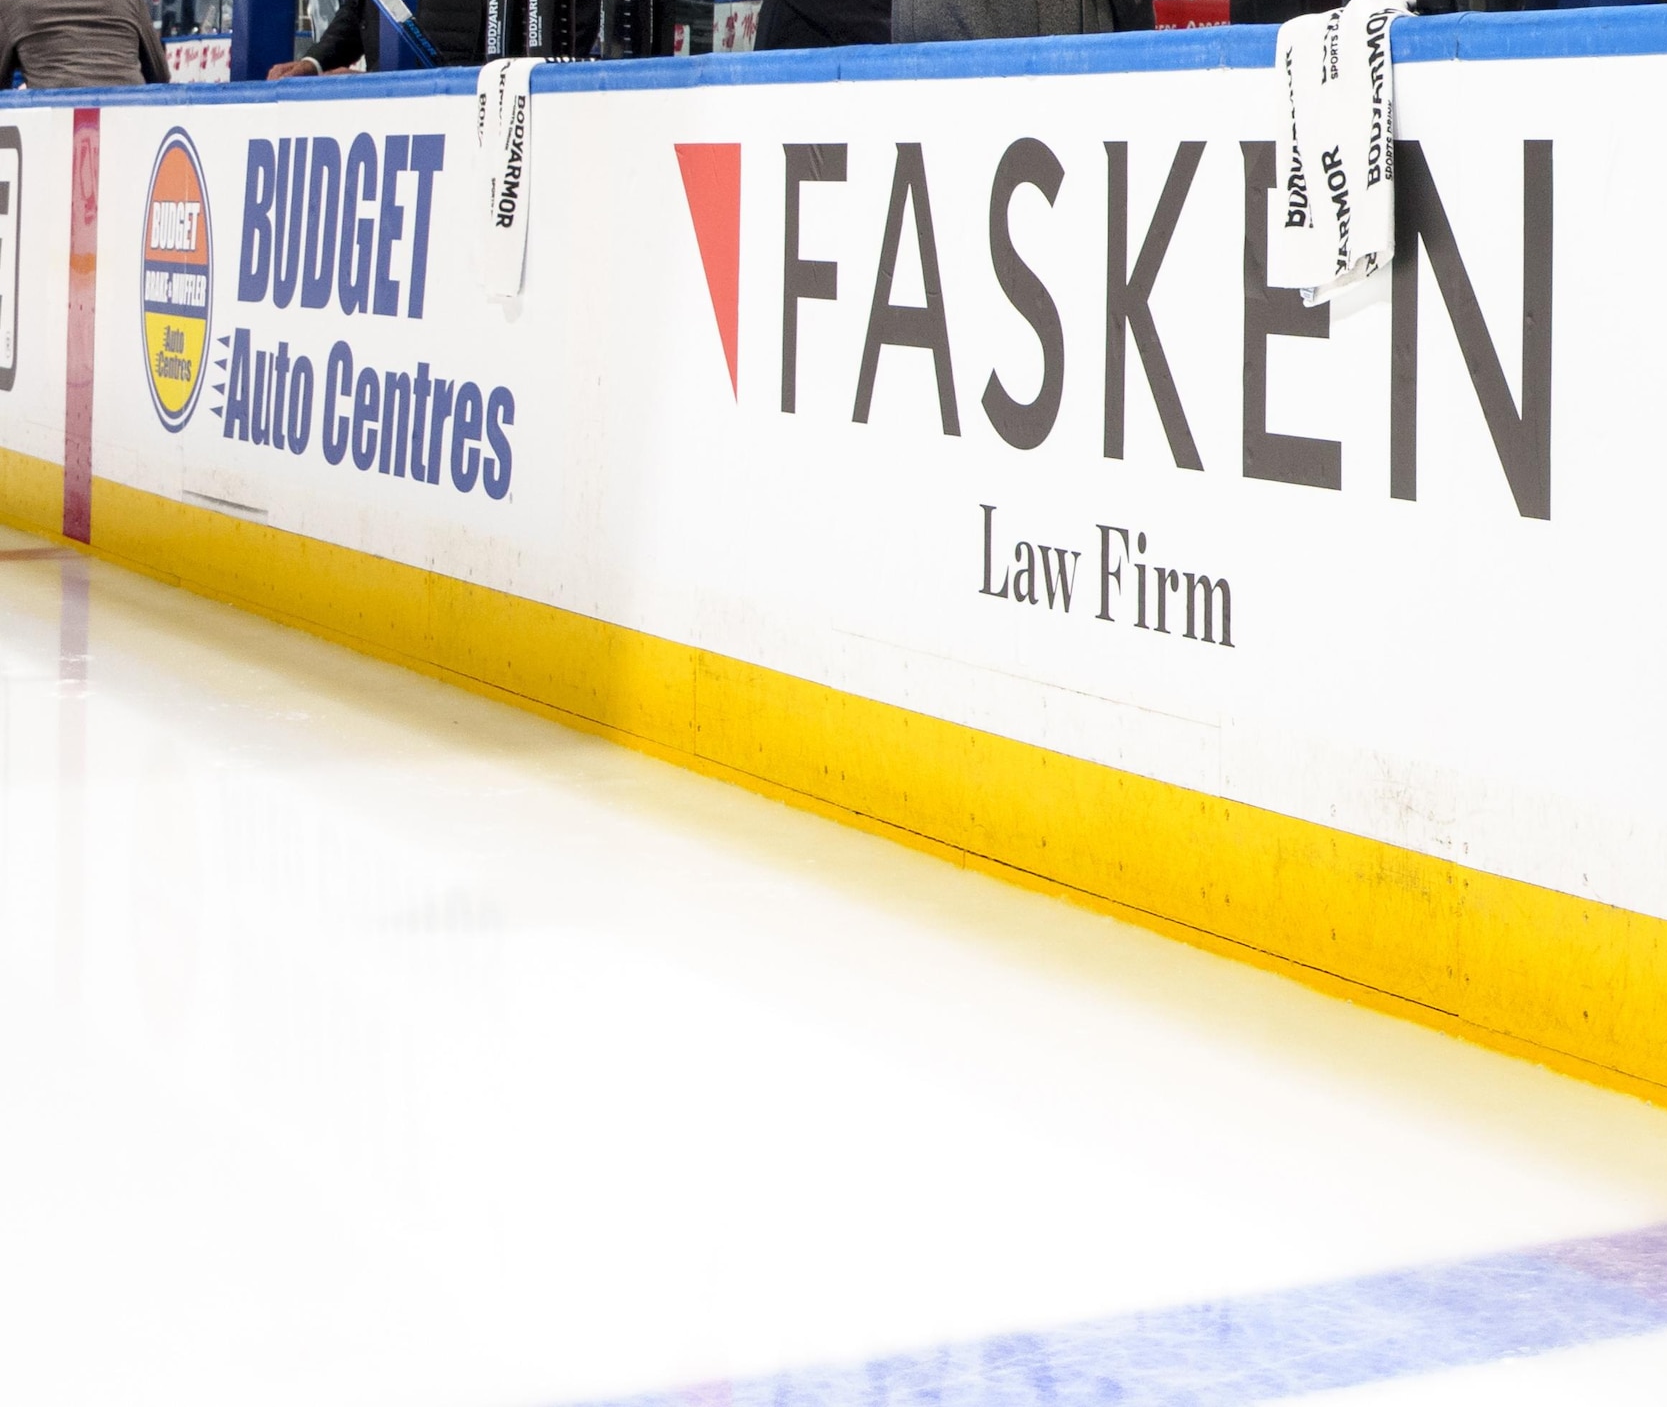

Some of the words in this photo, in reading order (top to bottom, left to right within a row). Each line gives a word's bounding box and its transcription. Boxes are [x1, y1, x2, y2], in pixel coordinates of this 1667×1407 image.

[150, 200, 201, 252] BUDGET
[237, 131, 446, 320] BUDGET
[495, 94, 526, 229] BODYARMOR
[1320, 144, 1351, 276] YARMOR
[155, 349, 192, 383] Centres
[163, 324, 185, 353] Auto
[781, 136, 1554, 521] FASKEN
[223, 327, 314, 456] Auto
[322, 339, 516, 501] Centres
[979, 504, 1080, 614] Law
[1095, 523, 1236, 649] Firm
